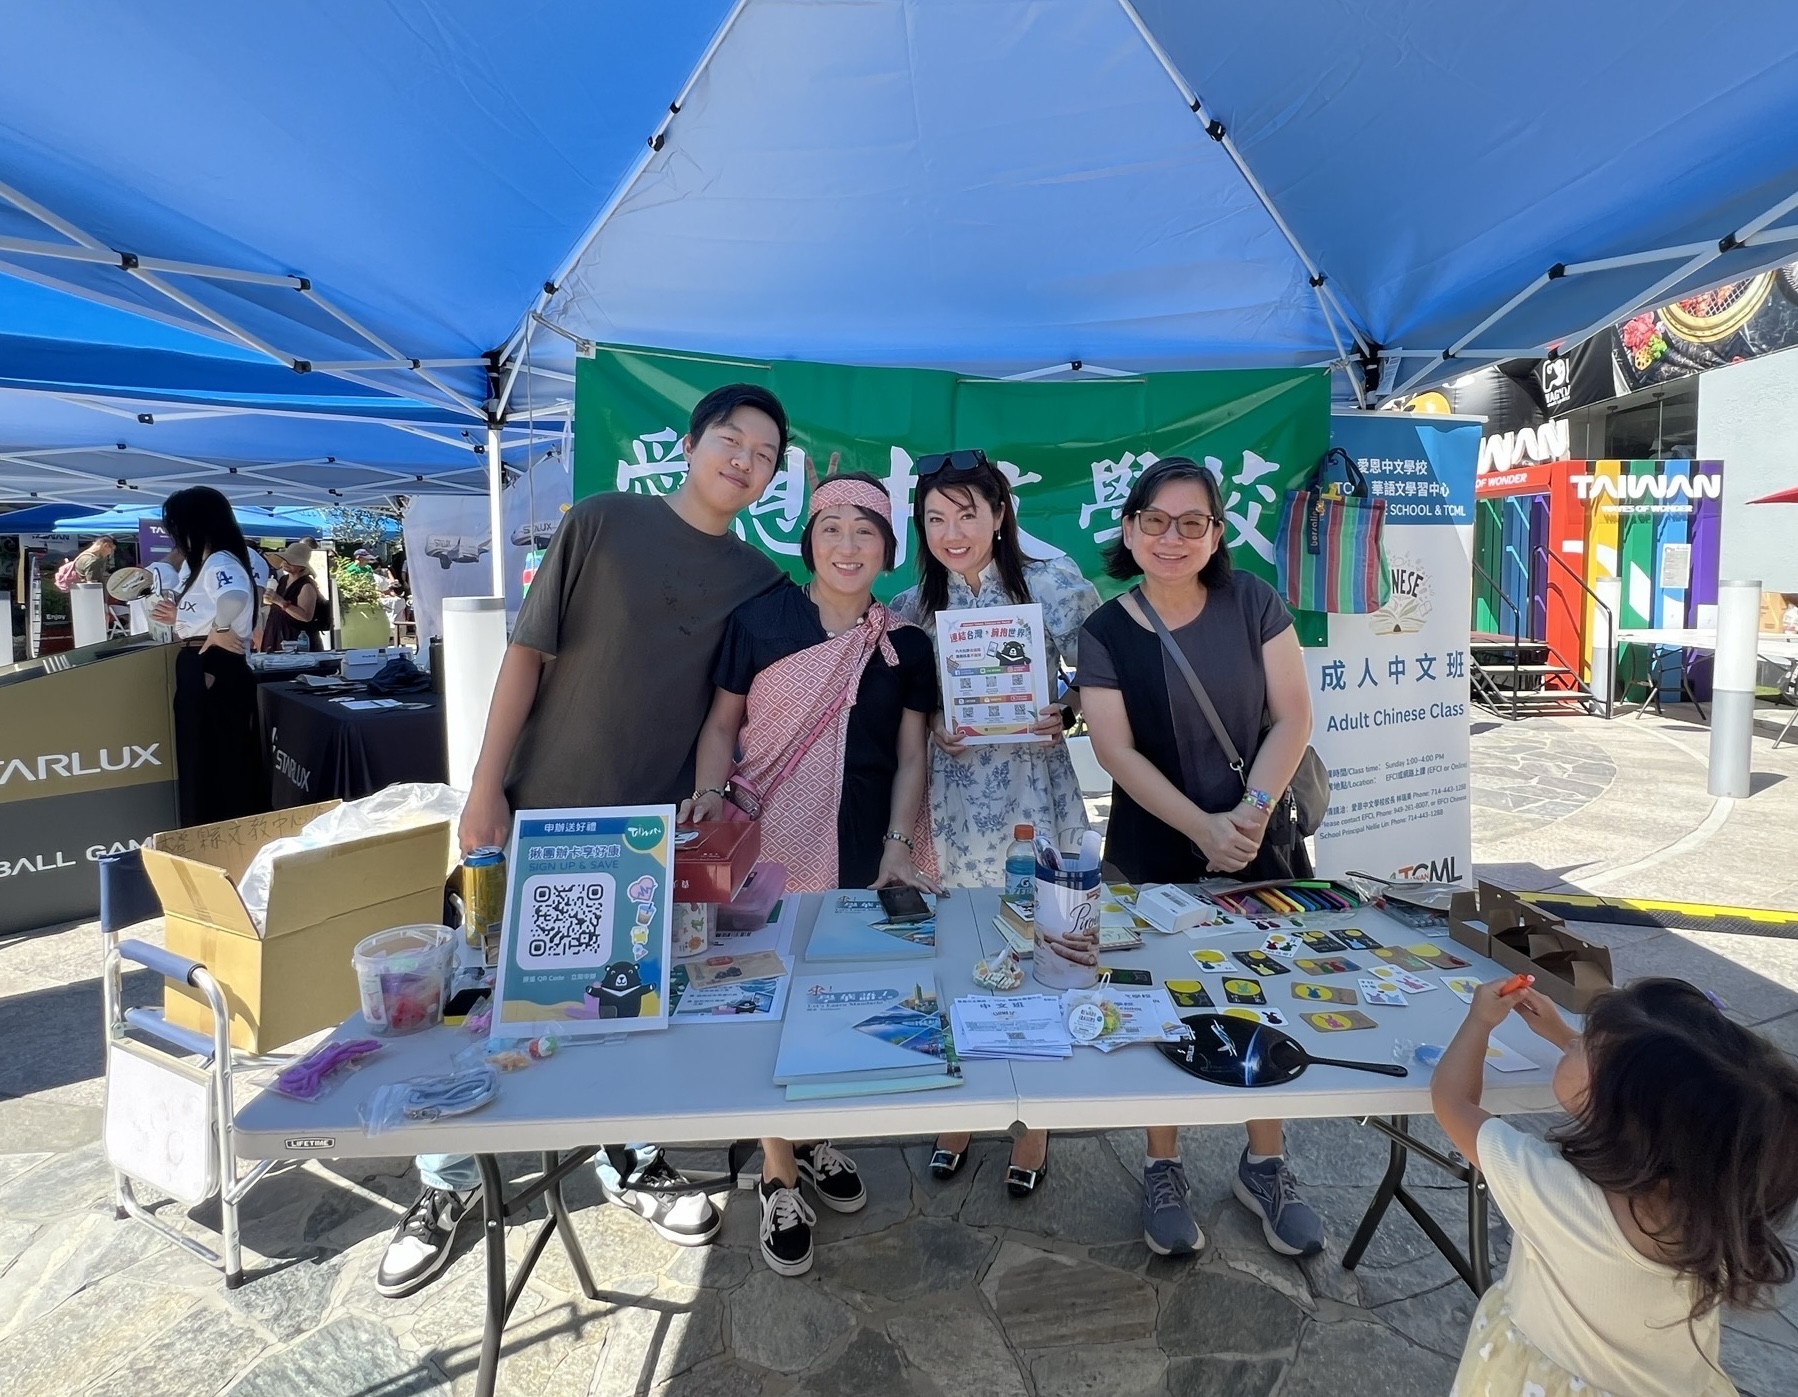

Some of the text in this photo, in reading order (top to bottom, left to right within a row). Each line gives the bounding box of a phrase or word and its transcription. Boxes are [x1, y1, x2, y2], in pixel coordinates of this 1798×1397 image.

[1357, 458, 1428, 475] 愛恩中文學校
[1488, 473, 1527, 487] WONDER
[1570, 474, 1721, 499] TAIWAN
[1371, 480, 1450, 498] 華語文學習中心
[1390, 503, 1432, 516] SCHOOL
[1435, 504, 1442, 516] &
[1444, 504, 1466, 517] TCML
[1601, 505, 1693, 513] WAVES OF WONDER
[46, 613, 66, 621] Enjoy
[1321, 650, 1465, 692] 成人中文班
[1326, 702, 1464, 732] Adult Chinese Class
[0, 742, 162, 786] ARLUX
[276, 750, 311, 793] STARLUX
[1385, 760, 1405, 770] Sunday
[544, 821, 597, 833] 申辦送好禮
[1340, 815, 1361, 825] contact
[1319, 831, 1341, 840] School
[1342, 825, 1365, 836] Principal
[528, 843, 622, 861] 揪團辦卡享好康
[528, 859, 620, 872] SIGN UP & SAVE
